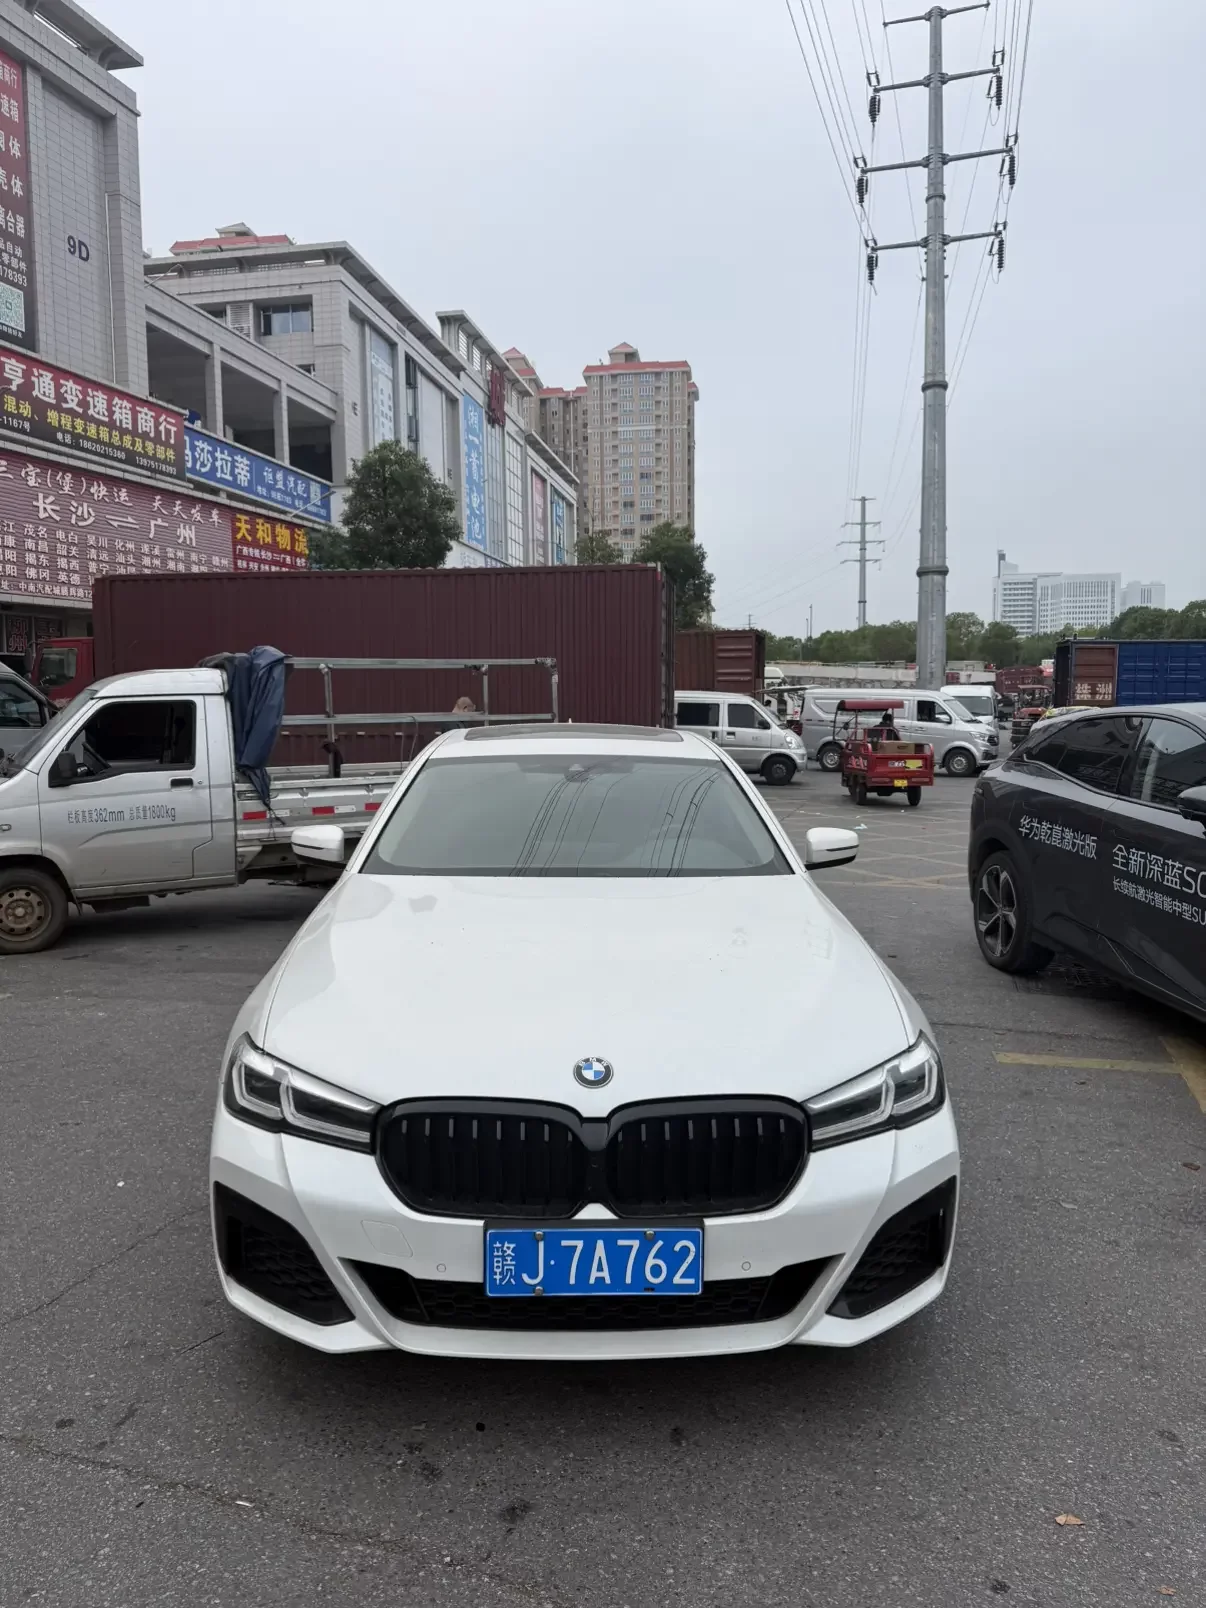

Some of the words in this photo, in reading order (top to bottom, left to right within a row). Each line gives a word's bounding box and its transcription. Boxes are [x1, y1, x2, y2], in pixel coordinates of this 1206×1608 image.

[67, 235, 90, 262] 9D
[1, 356, 177, 445] 亨通变速箱商行
[32, 492, 96, 527] 长沙
[149, 518, 196, 546] 广州
[236, 514, 309, 556] 天和物流
[0, 520, 15, 533] 江
[24, 523, 48, 539] 茂名
[56, 530, 78, 544] 电白
[115, 539, 135, 552] 化州
[0, 535, 16, 548] 康
[24, 539, 48, 553] 南昌
[56, 543, 79, 558] 韶关
[0, 549, 16, 563] 阳
[24, 552, 49, 567] 揭东
[57, 557, 79, 571] 揭西
[25, 567, 49, 580] 佛冈
[57, 571, 80, 585] 英德
[493, 1240, 696, 1286] 赣J·7A762
